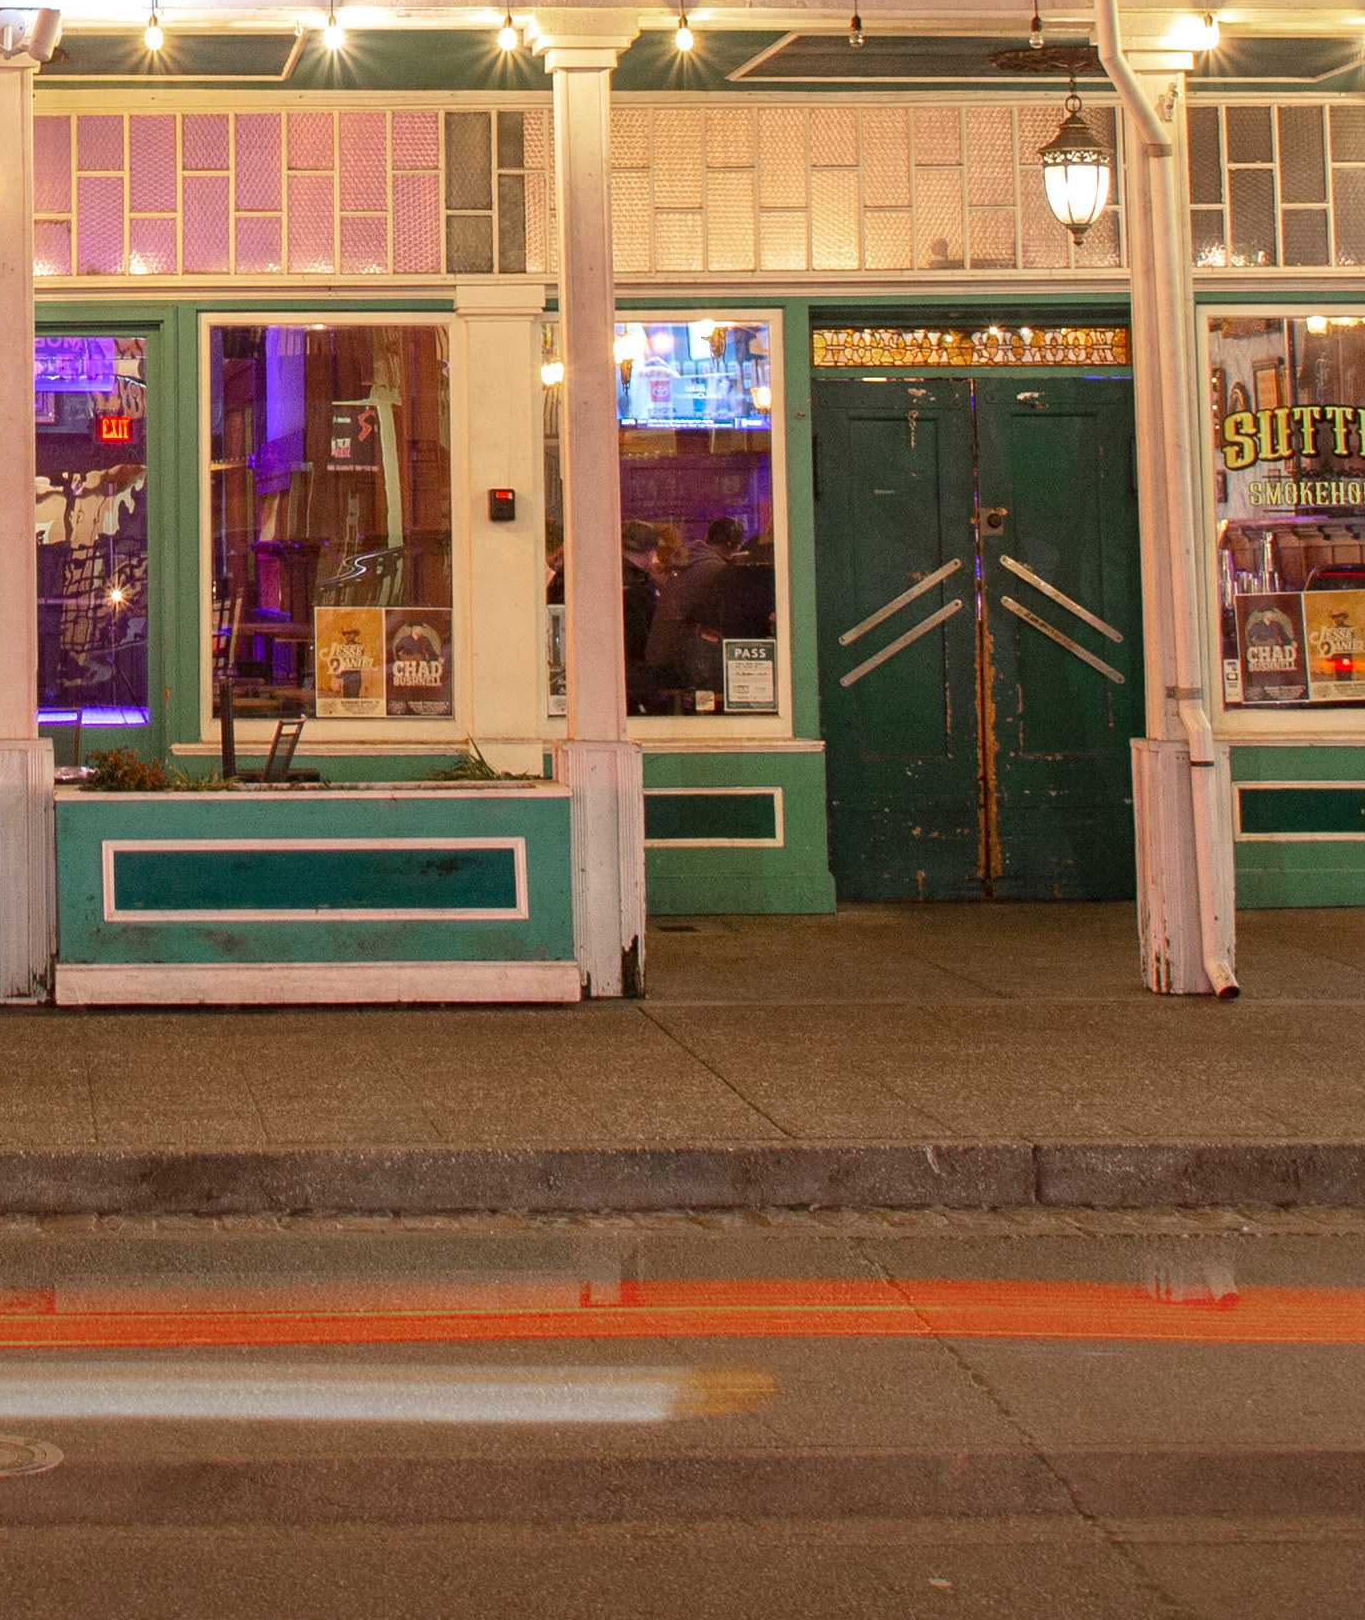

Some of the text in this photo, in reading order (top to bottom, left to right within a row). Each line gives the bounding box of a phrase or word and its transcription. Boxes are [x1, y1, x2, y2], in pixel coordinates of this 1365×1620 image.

[102, 417, 130, 439] EXIT
[1221, 405, 1365, 470] SUTT
[1249, 481, 1365, 506] SMOKEHO
[734, 648, 766, 659] PASS
[1247, 645, 1296, 661] CHAD
[392, 661, 443, 677] CHAD
